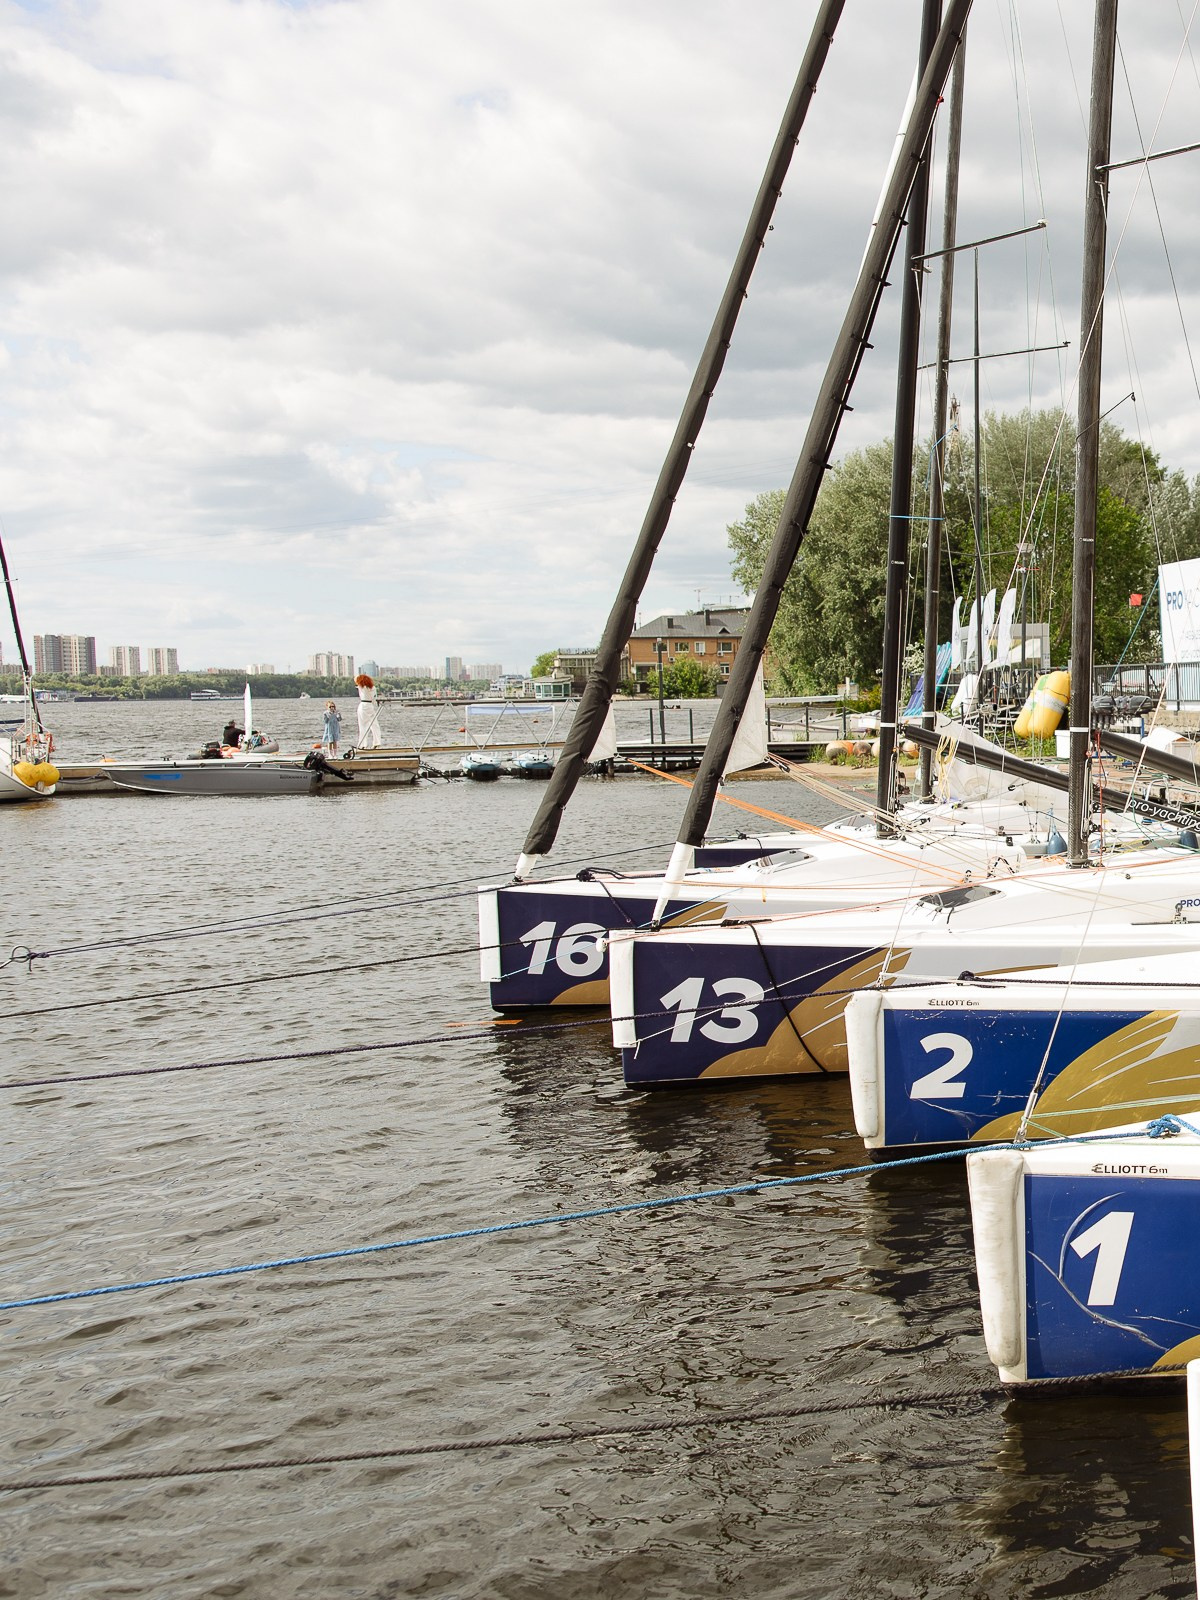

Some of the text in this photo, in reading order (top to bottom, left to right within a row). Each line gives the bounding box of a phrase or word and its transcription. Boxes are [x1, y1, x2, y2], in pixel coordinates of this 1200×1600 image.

[518, 921, 608, 977] 16
[659, 977, 765, 1044] 13
[928, 998, 965, 1006] ELLIOTT
[909, 1032, 974, 1099] 2
[1091, 1163, 1168, 1174] ELLIOTT 6m
[1069, 1211, 1135, 1306] 1
